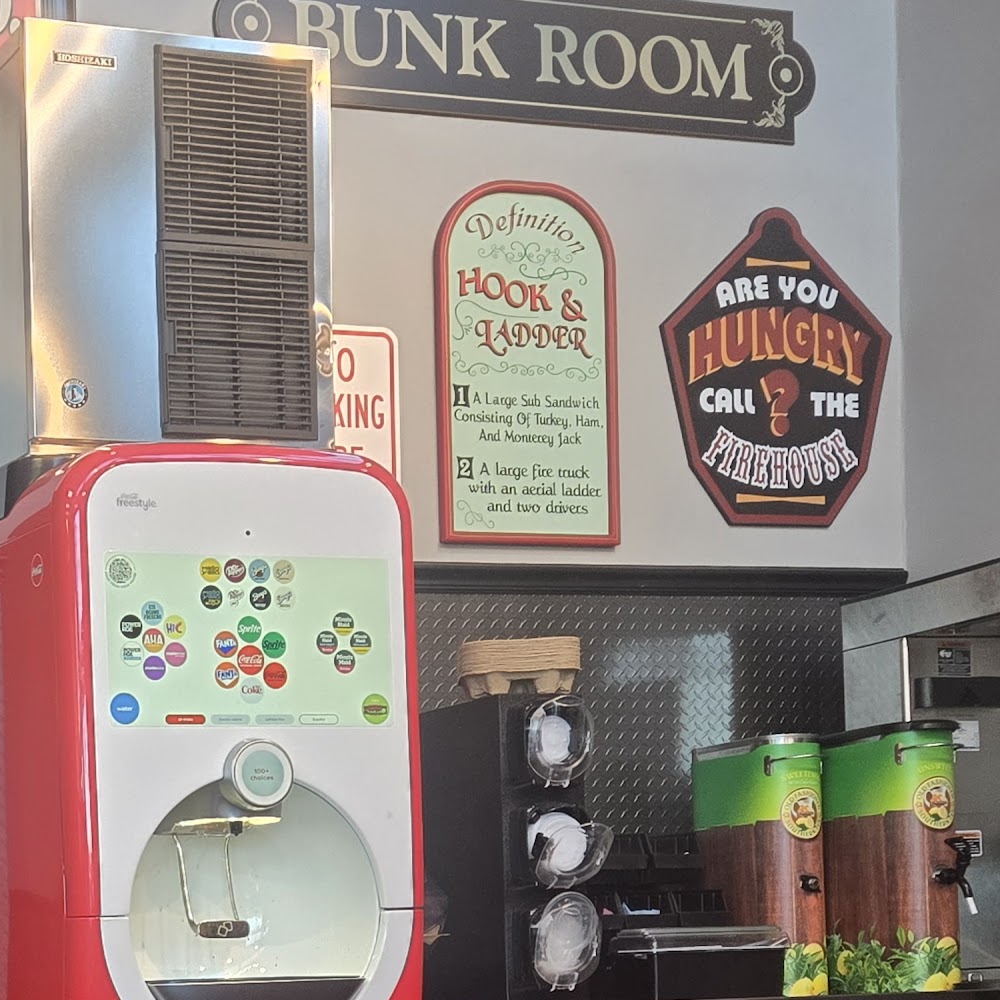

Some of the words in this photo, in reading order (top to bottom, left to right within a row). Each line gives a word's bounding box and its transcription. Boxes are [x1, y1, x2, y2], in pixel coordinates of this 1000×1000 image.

[56, 53, 113, 66] HOSHIZAKI
[295, 0, 509, 80] BUNK
[535, 22, 754, 102] ROOM
[465, 202, 585, 255] Definition
[457, 267, 552, 313] HOOK
[561, 288, 588, 322] &
[715, 275, 769, 308] ARE
[778, 275, 838, 310] YOU
[474, 318, 593, 359] LADDER
[687, 307, 872, 386] HUNGRY
[337, 347, 355, 383] O
[455, 385, 468, 406] 1
[473, 391, 481, 405] A
[485, 392, 517, 409] Large
[521, 394, 541, 407] Sub
[545, 395, 600, 409] Sandwich
[699, 388, 755, 414] CALL
[810, 392, 859, 418] THE
[334, 393, 385, 429] KING
[454, 408, 513, 427] Consisting
[517, 412, 531, 428] Of
[534, 413, 572, 430] Turkey,
[576, 415, 604, 428] Ham,
[479, 428, 501, 442] And
[504, 429, 554, 447] Monterey
[558, 432, 582, 448] Jack
[458, 457, 472, 478] 2
[480, 462, 490, 476] A
[495, 462, 528, 480] large
[532, 463, 554, 480] fire
[558, 465, 590, 479] truck
[701, 425, 858, 490] FIREHOUSE
[468, 480, 496, 494] with
[501, 485, 517, 495] an
[522, 482, 557, 496] aerial
[562, 483, 602, 497] ladder
[116, 497, 157, 511] freestyle
[487, 499, 512, 512] and
[517, 501, 541, 513] two
[546, 500, 589, 514] drivers
[144, 634, 163, 645] AHA
[238, 624, 261, 635] Sprite
[263, 640, 286, 650] Sprite
